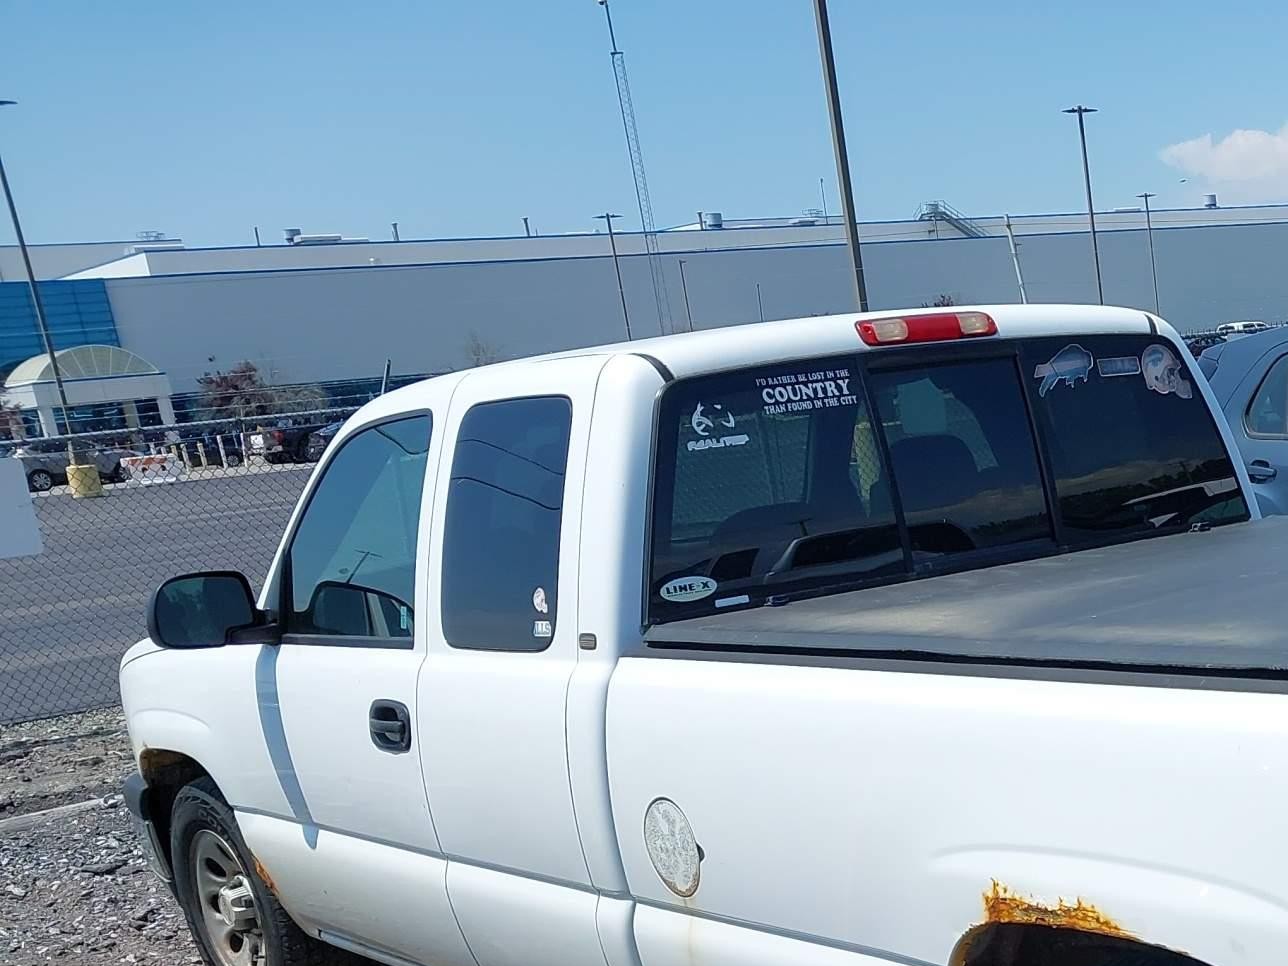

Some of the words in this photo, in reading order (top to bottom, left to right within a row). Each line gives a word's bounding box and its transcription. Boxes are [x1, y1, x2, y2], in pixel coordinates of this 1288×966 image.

[756, 378, 766, 387] I'D
[768, 375, 797, 385] RATHER
[797, 373, 808, 382] BE
[808, 371, 825, 381] LOST
[826, 370, 834, 379] IN
[835, 368, 850, 378] THE
[762, 379, 850, 403] COUNTRY
[764, 403, 787, 415] THAN
[787, 401, 813, 411] FOUND
[814, 399, 823, 409] IN
[823, 397, 840, 408] THE
[840, 395, 857, 405] CITY
